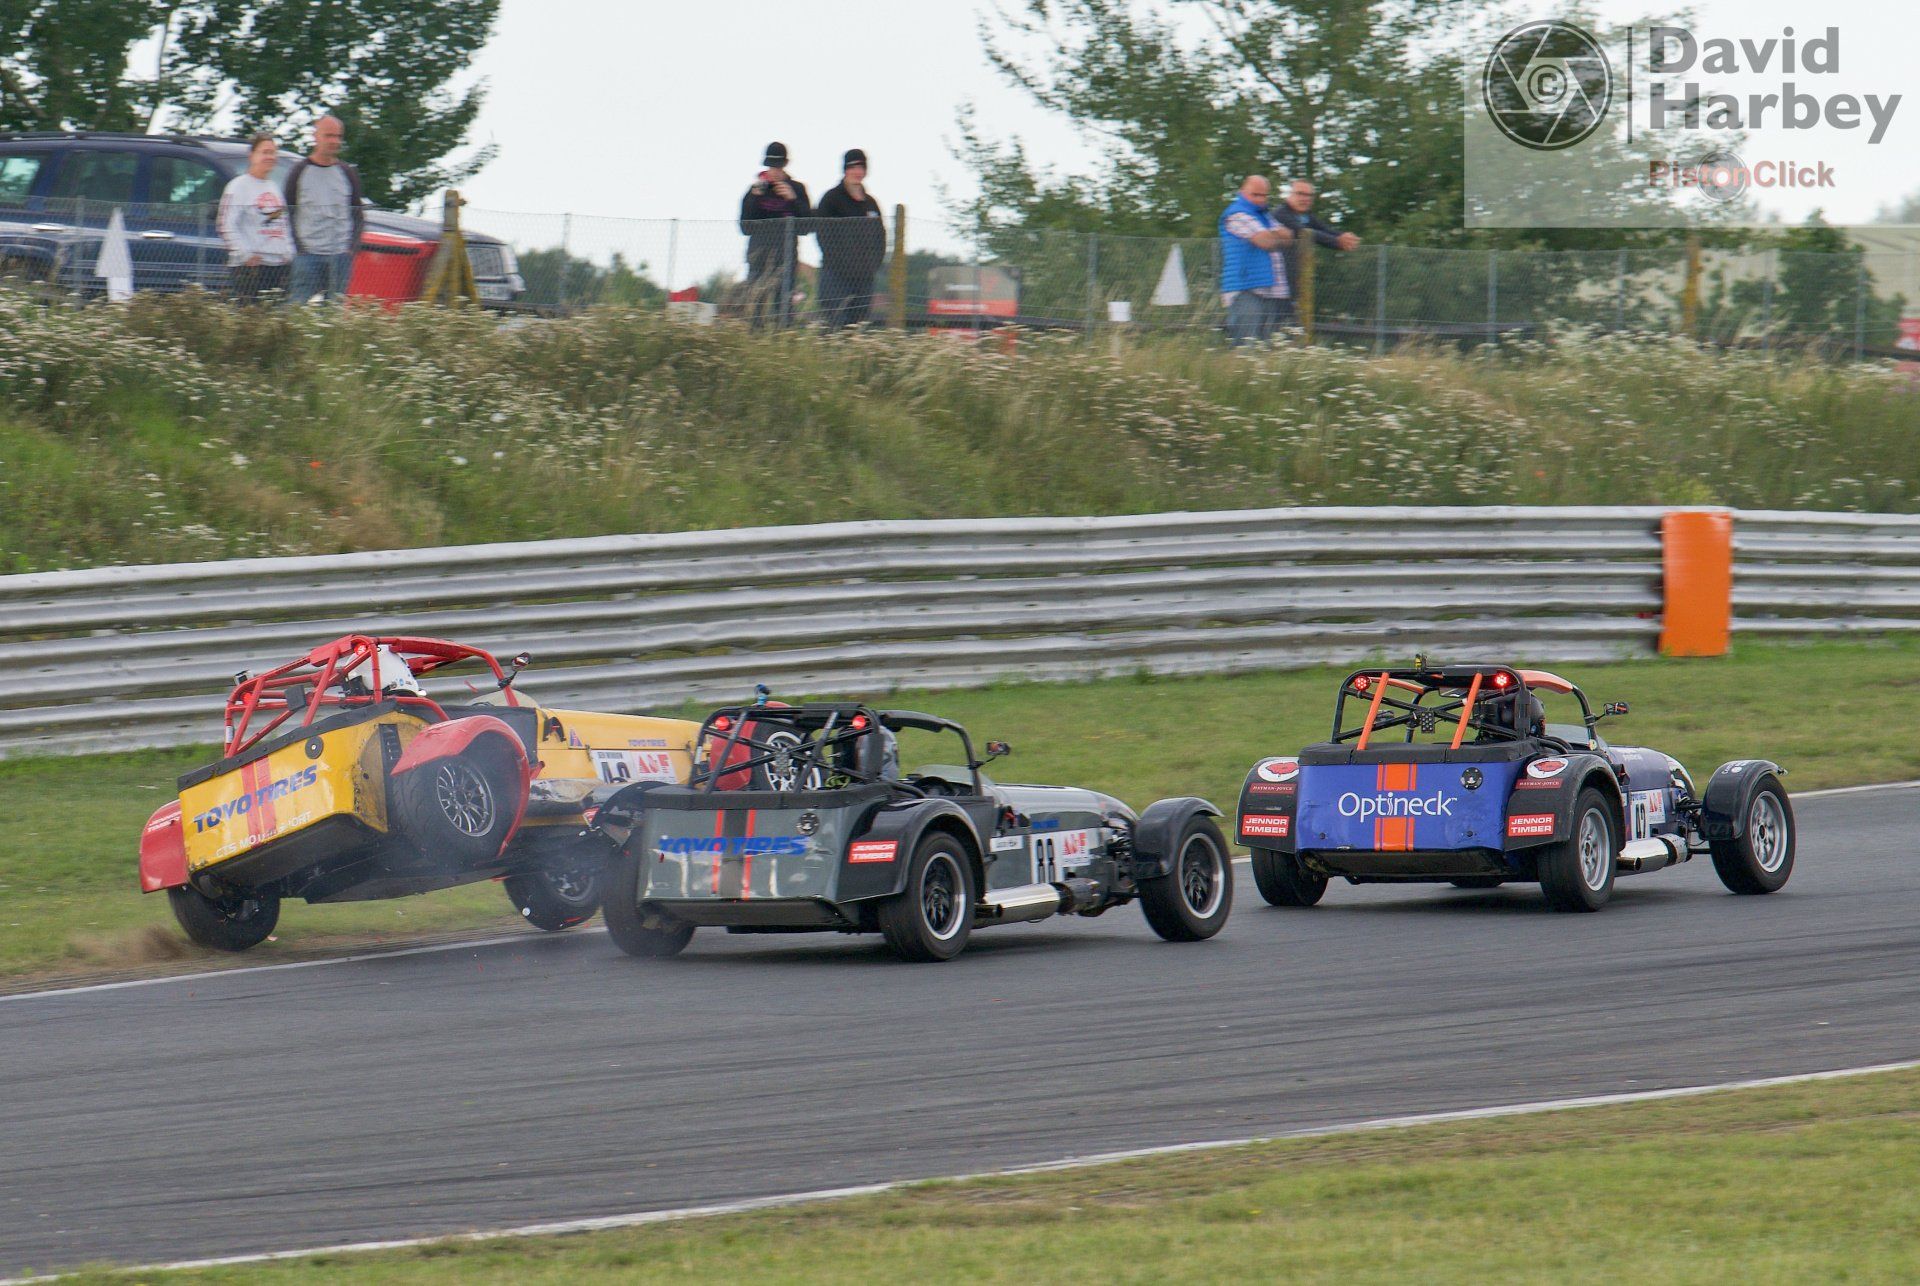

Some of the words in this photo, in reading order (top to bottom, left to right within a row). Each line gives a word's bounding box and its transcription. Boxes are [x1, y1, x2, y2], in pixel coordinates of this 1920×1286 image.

[193, 793, 252, 833] TOYO
[255, 764, 318, 807] TIRES
[1338, 790, 1453, 823] Optineck
[1245, 817, 1288, 825] JENNOR
[1511, 816, 1553, 825] JENNOR
[239, 811, 312, 848] MOSORT
[1244, 826, 1287, 834] TIMBER
[1510, 825, 1552, 834] TIMBER
[658, 837, 726, 853] TOYO
[732, 836, 810, 855] TIRES
